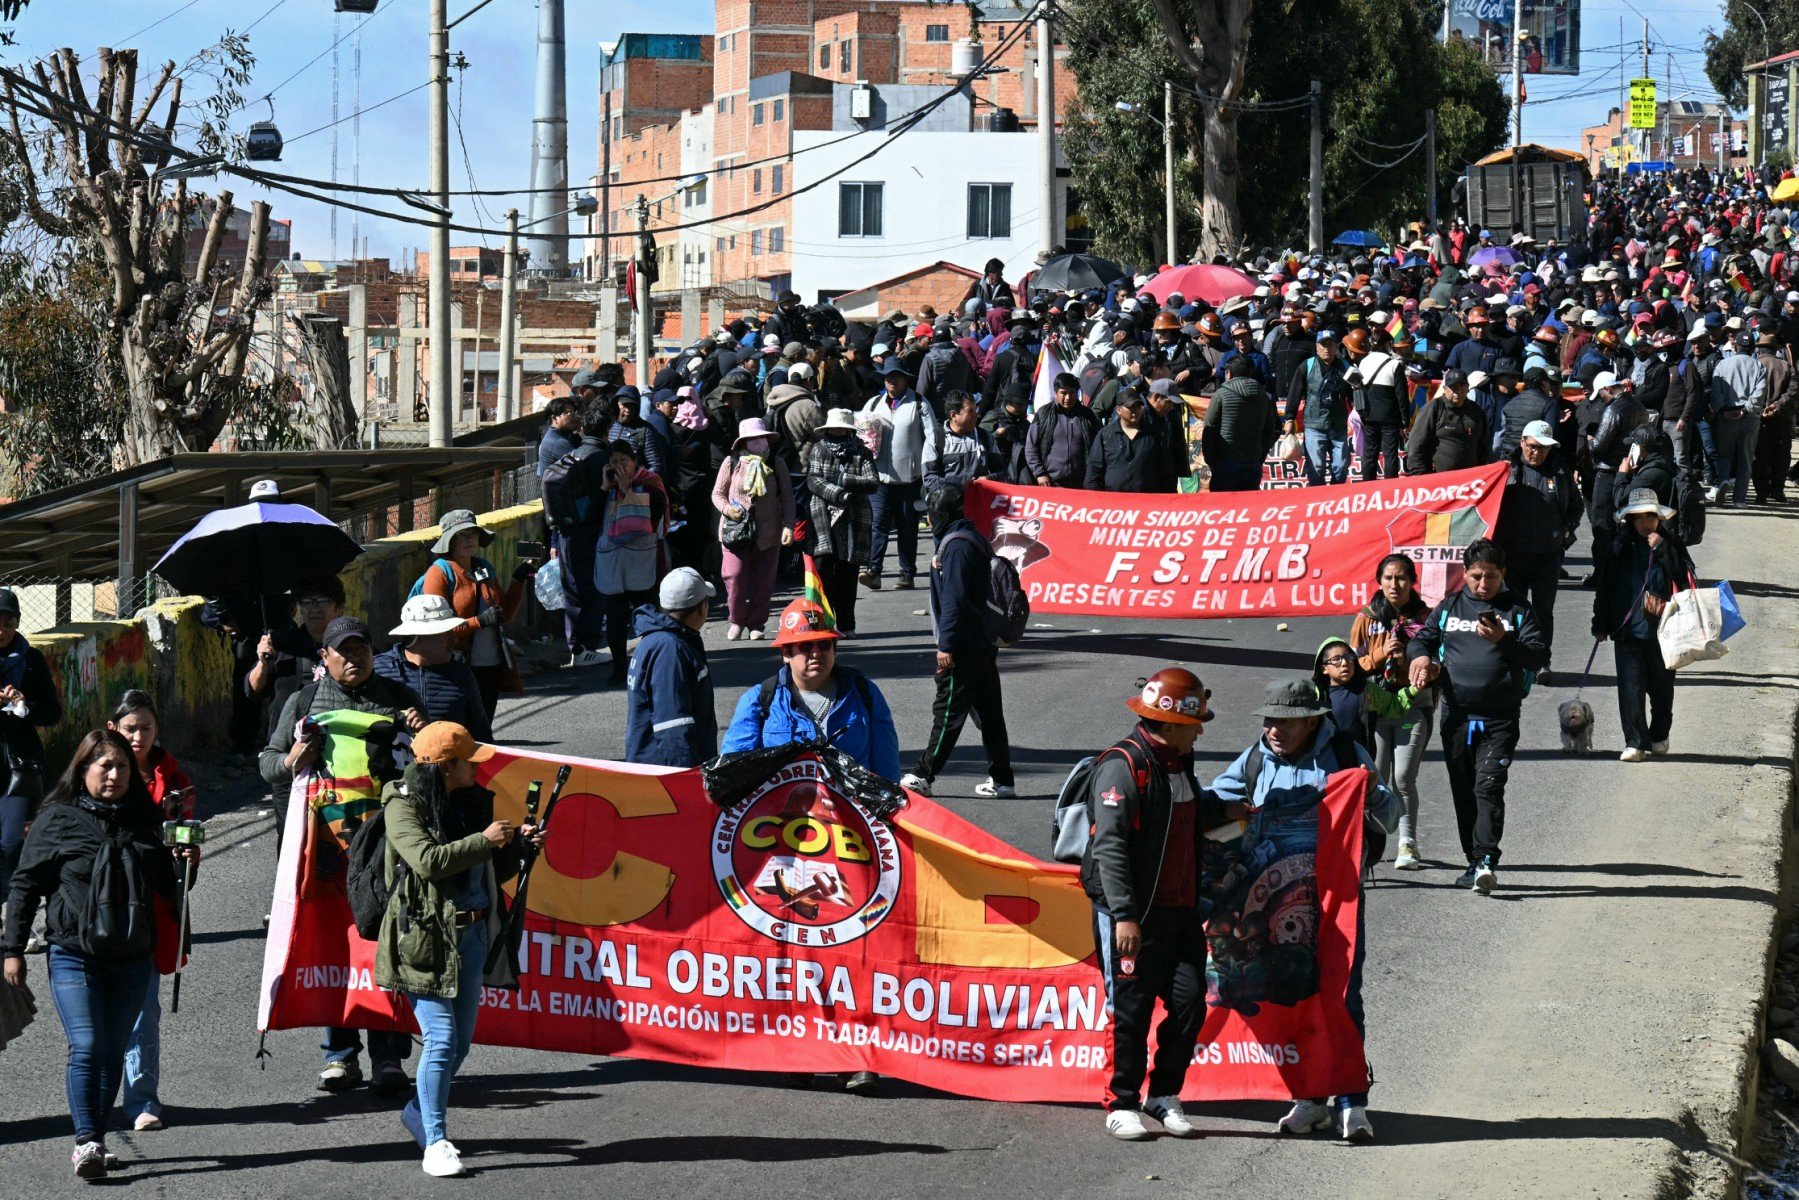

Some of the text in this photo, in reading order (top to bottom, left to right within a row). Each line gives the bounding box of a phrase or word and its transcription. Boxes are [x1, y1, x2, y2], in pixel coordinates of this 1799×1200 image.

[991, 479, 1487, 528] FEDERACION SINDICAL DE TRABAJADORES
[1089, 518, 1351, 548] MINEROS DE BOLIVIA
[1028, 582, 1368, 611] PRESENTES EN LA LUCH
[741, 815, 873, 863] COB
[516, 929, 652, 989] TRAL
[666, 949, 857, 1011] OBRERA
[295, 965, 374, 991] FUNDADA
[516, 989, 542, 1013] LA
[549, 992, 720, 1033] EMANCIPACIÓN
[726, 1011, 756, 1034] DE
[763, 1013, 806, 1038] LOS
[813, 1017, 986, 1064] TRABAJADORES
[993, 1039, 1053, 1068] SERÁ
[1060, 1045, 1107, 1070] OBR
[1227, 1041, 1300, 1065] MISMOS
